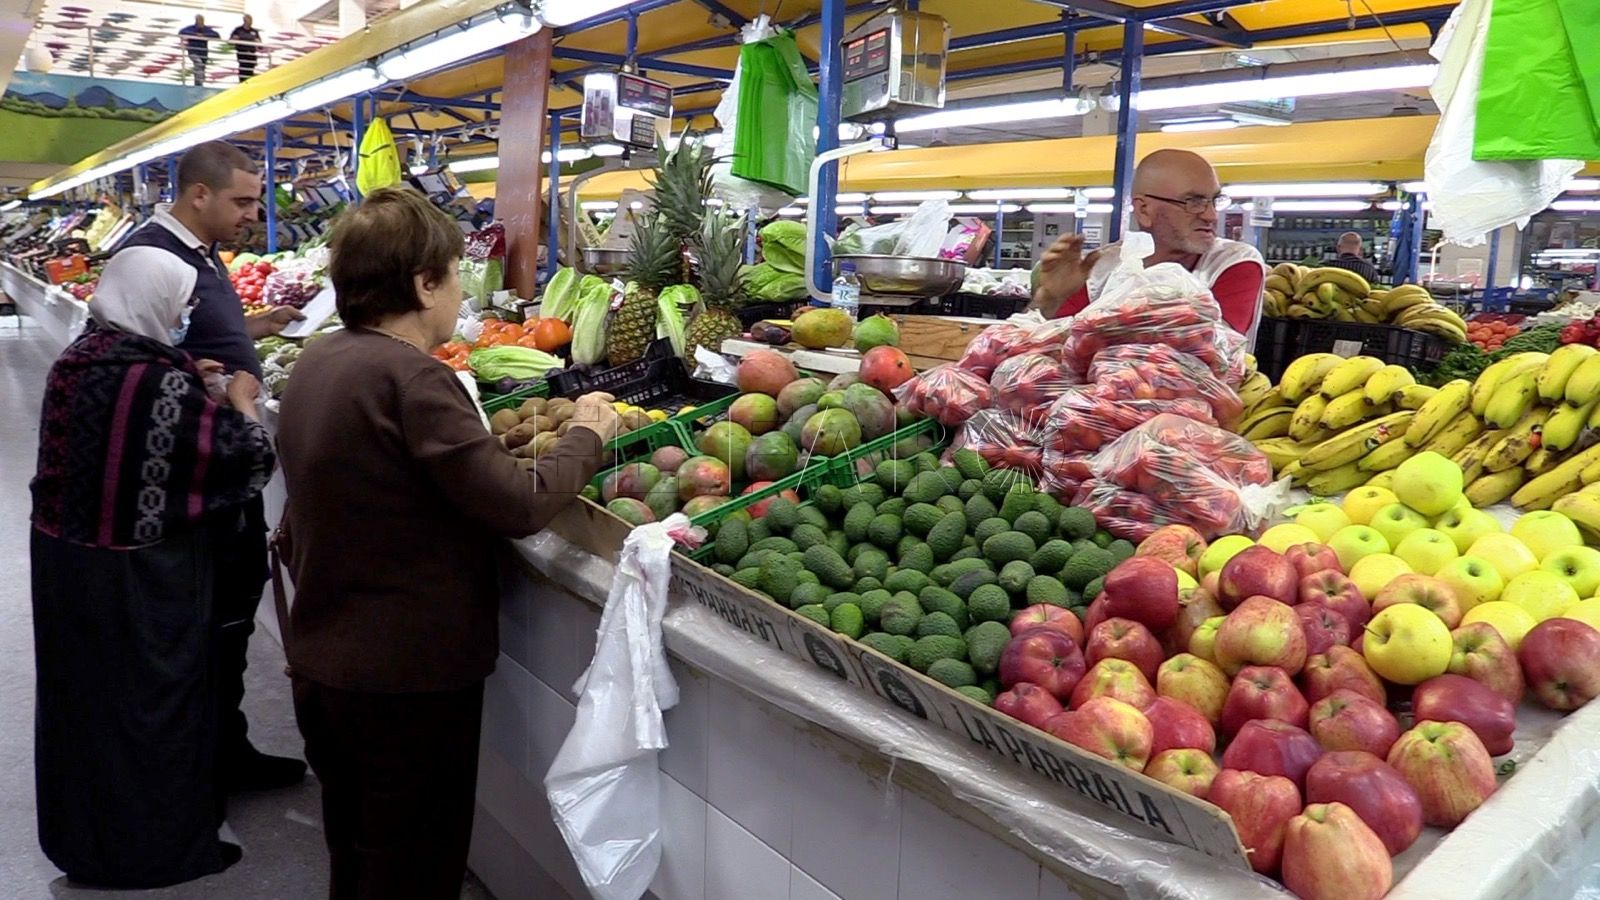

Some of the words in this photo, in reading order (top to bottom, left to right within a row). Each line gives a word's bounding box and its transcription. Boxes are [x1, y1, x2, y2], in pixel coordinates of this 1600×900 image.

[752, 613, 784, 651] LA
[951, 702, 1004, 756] LA
[994, 723, 1173, 835] PARRALA
